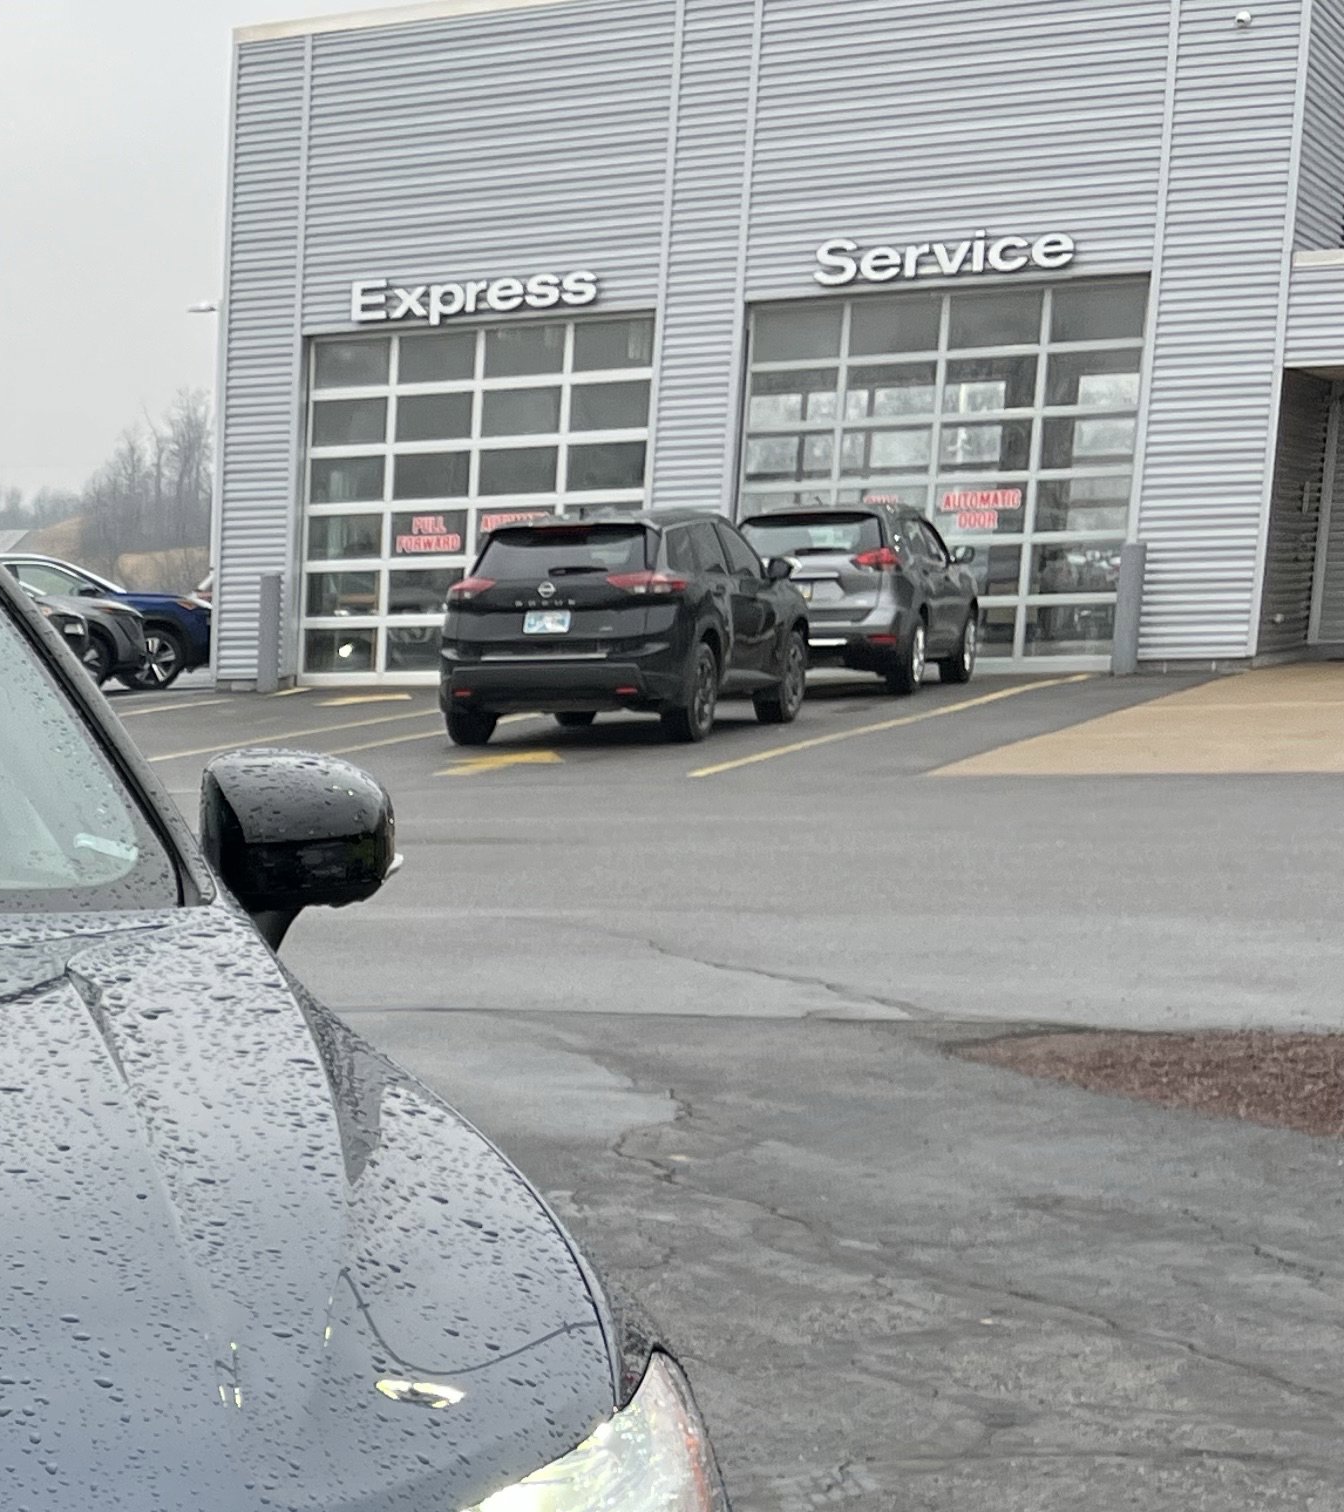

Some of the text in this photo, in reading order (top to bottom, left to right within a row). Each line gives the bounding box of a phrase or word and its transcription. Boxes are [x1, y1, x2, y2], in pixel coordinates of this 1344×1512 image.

[351, 229, 1075, 326] Express Service
[942, 489, 1021, 511] AUTOMATIC
[957, 511, 998, 529] DOOR
[396, 533, 461, 554] FORWARD
